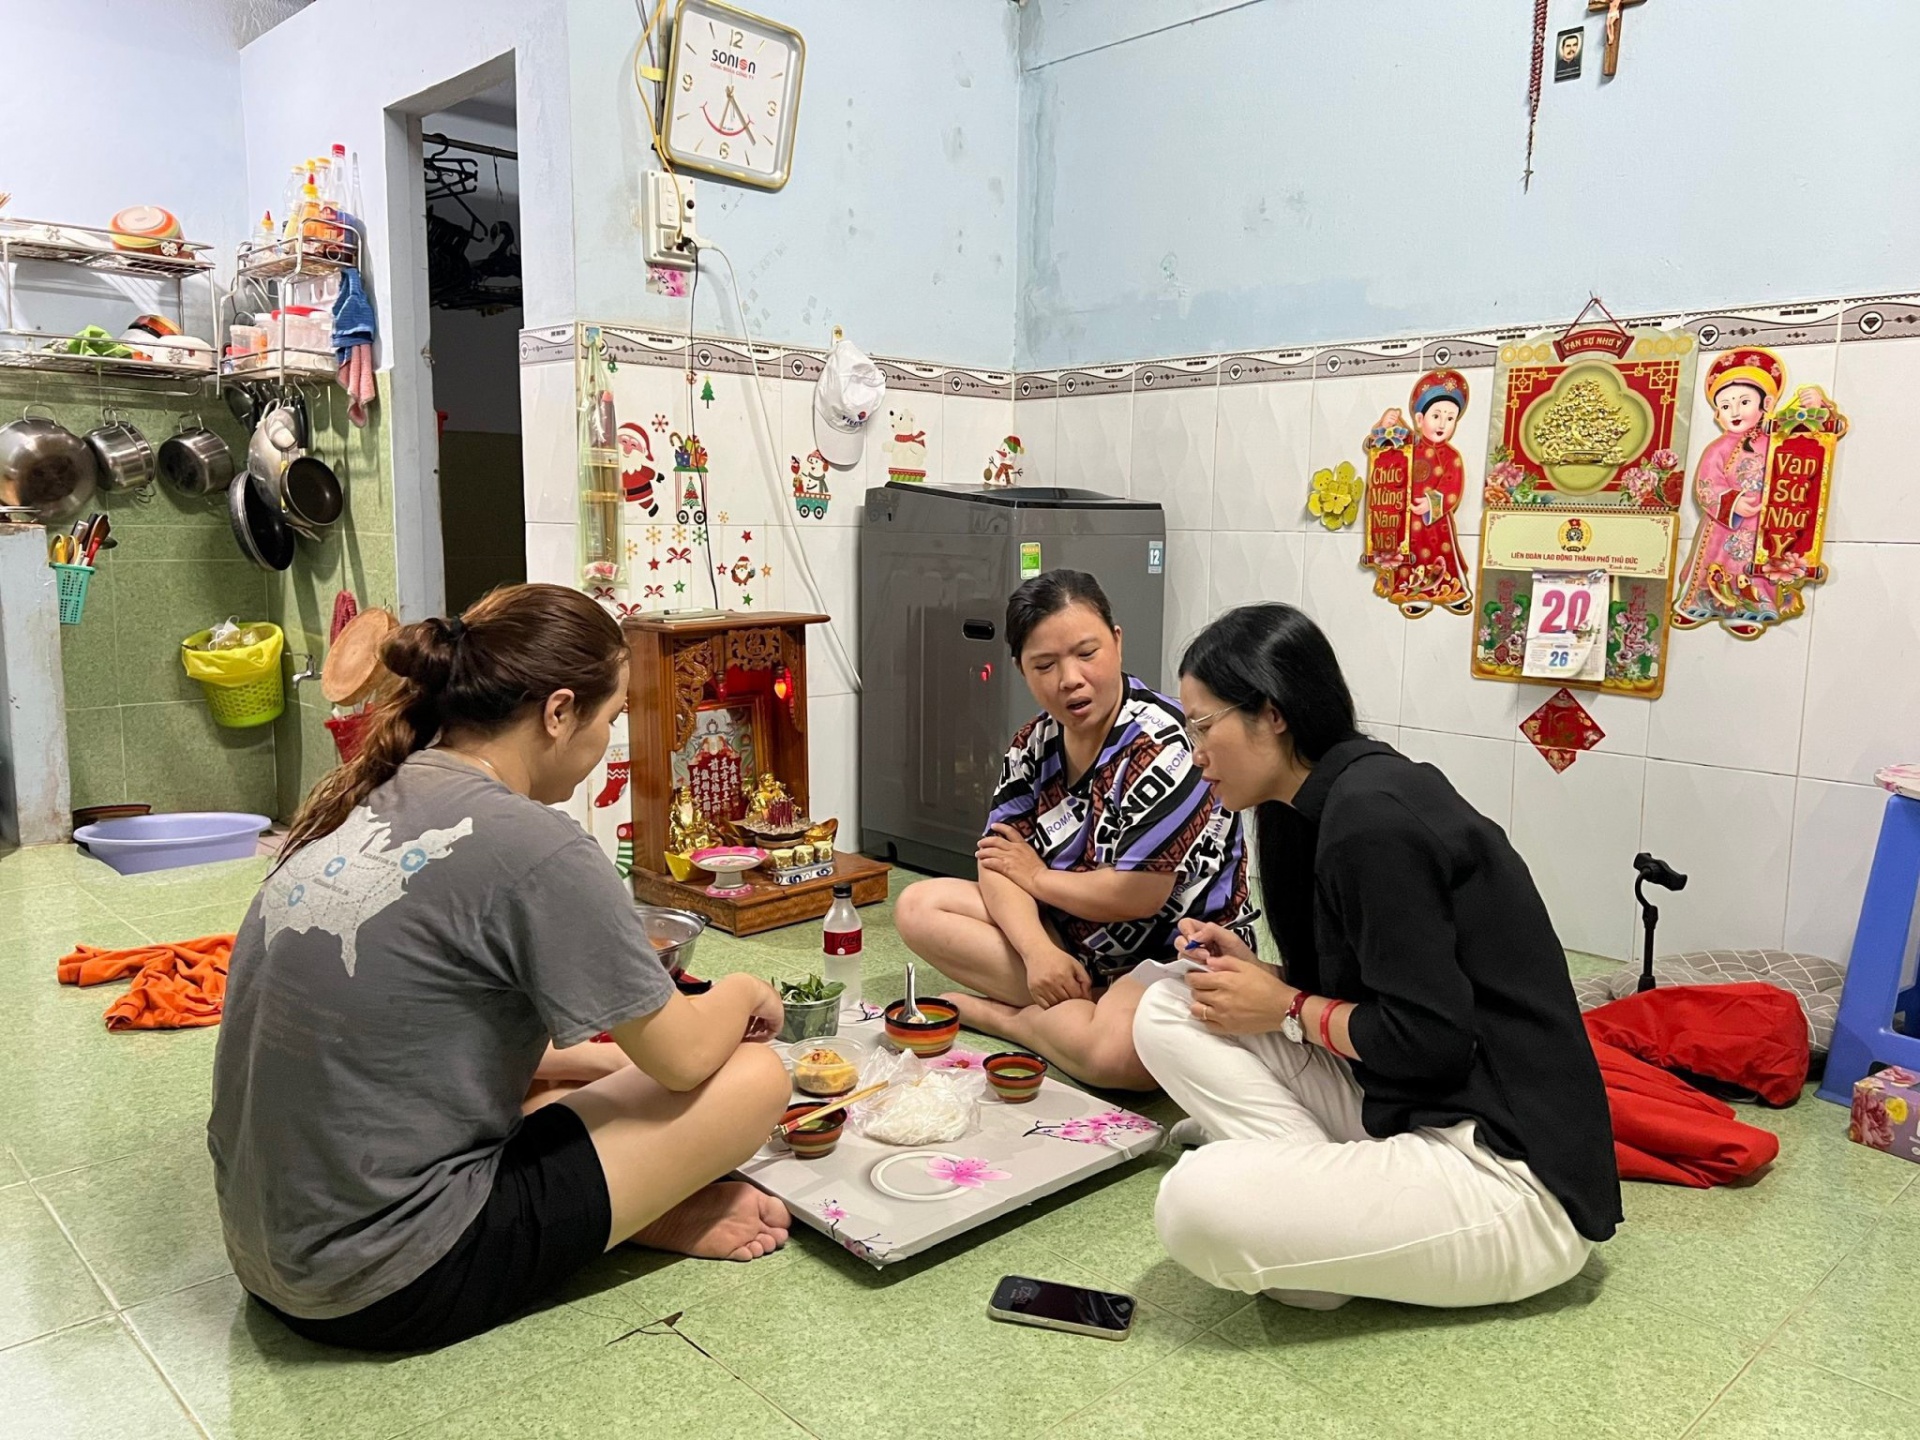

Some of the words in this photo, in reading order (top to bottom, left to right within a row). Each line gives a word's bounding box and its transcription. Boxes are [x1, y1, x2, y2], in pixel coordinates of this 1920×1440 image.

[729, 29, 744, 49] 12
[682, 73, 693, 92] 9
[767, 100, 777, 117] 3
[719, 142, 730, 160] 6
[1373, 463, 1403, 485] Chúc
[1777, 453, 1817, 480] Vạn
[1371, 487, 1403, 510] Mừng
[1773, 479, 1810, 506] Sự
[1373, 510, 1400, 529] Năm
[1764, 506, 1811, 529] Như
[1374, 531, 1398, 550] Mới
[1771, 532, 1796, 558] Ý
[1150, 549, 1160, 565] 12
[1525, 552, 1542, 560] ĐOÀN
[1596, 554, 1611, 563] PHỐ
[1538, 589, 1591, 633] 20
[1549, 650, 1569, 667] 26
[1165, 747, 1188, 775] ROM
[1046, 812, 1074, 836] ROMA
